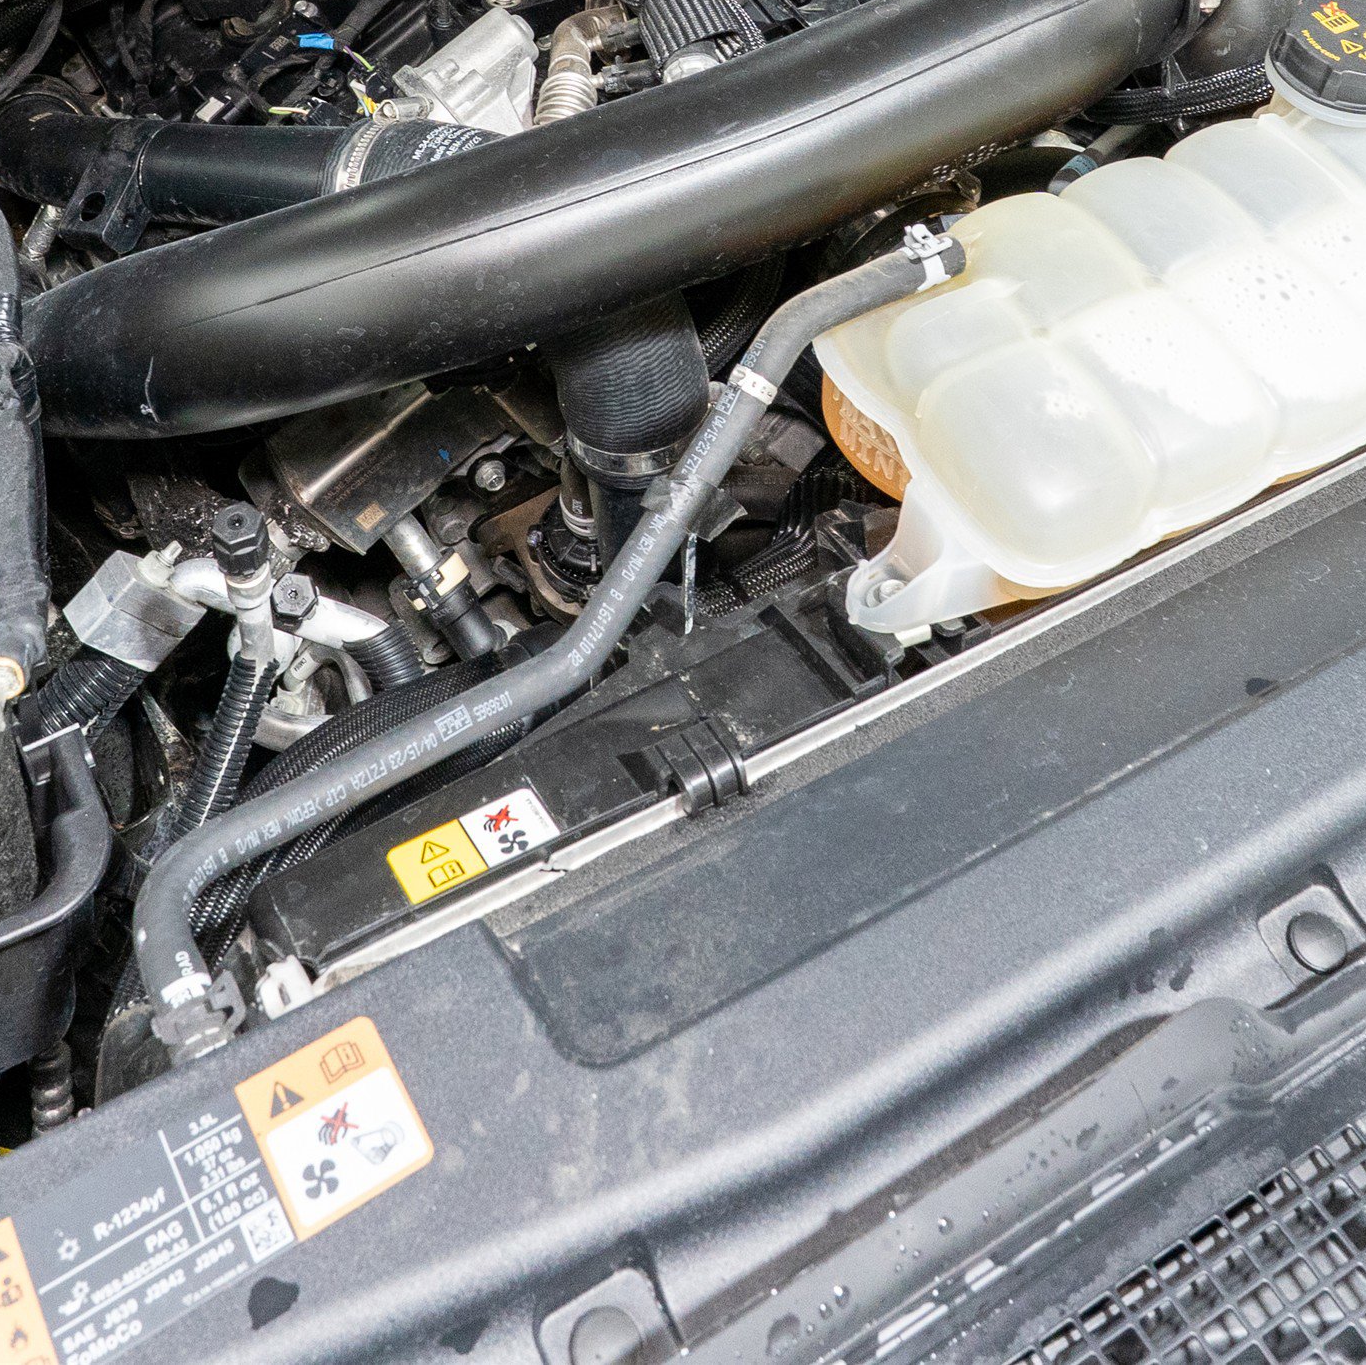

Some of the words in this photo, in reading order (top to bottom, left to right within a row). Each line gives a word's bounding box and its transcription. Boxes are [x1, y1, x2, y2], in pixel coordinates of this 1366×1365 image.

[699, 415, 726, 456] 04/15/23
[636, 534, 656, 555] MEX
[578, 601, 615, 654] 16:17:10
[388, 733, 437, 770] 04/15/23
[326, 785, 348, 807] CIP
[175, 950, 195, 975] RAD
[184, 1135, 221, 1167] 1.050
[221, 1126, 242, 1146] kg
[200, 1190, 224, 1214] 6.1
[240, 1172, 260, 1192] oz
[92, 1186, 166, 1241] R-1234yf
[144, 1220, 184, 1253] PAG
